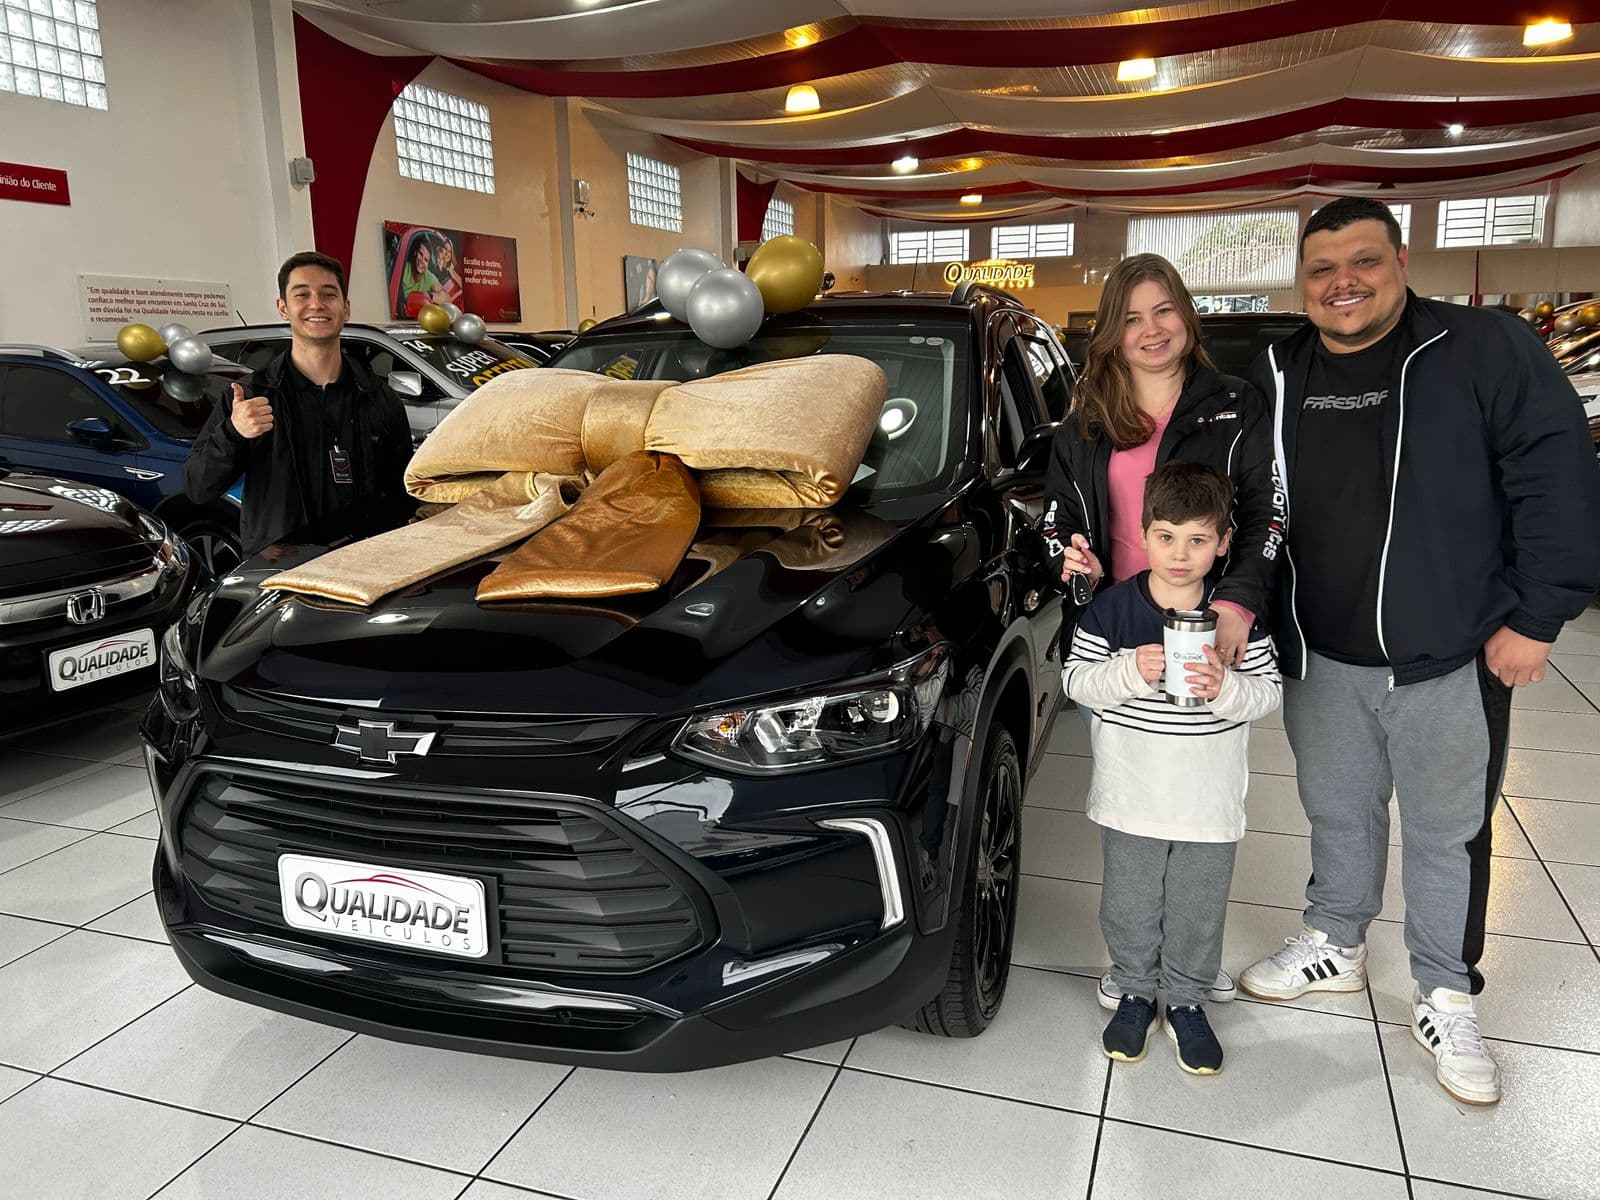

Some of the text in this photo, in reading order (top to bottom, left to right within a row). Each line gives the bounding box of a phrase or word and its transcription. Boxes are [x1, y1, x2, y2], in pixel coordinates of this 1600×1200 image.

[20, 177, 31, 188] do
[32, 179, 56, 191] Cliente
[464, 257, 480, 266] Escolha
[473, 268, 498, 277] garantimos
[944, 262, 1035, 286] QUALIDADE
[465, 276, 499, 286] melhor direção.
[101, 287, 129, 296] qualidade
[136, 288, 148, 296] bom
[149, 290, 183, 298] atendimento
[184, 291, 202, 300] sempre
[203, 292, 226, 300] podemos
[115, 297, 134, 305] melhor
[182, 300, 197, 308] Santa
[103, 306, 123, 314] dúvida
[124, 307, 132, 315] foi
[141, 307, 169, 316] Qualidade
[214, 310, 229, 318] confio
[402, 340, 434, 352] 14
[446, 350, 498, 377] SUPER
[95, 368, 151, 384] 22
[1302, 389, 1389, 410] FREESURF
[59, 642, 148, 681] QUALIDADE
[294, 871, 470, 935] QUALIDADE
